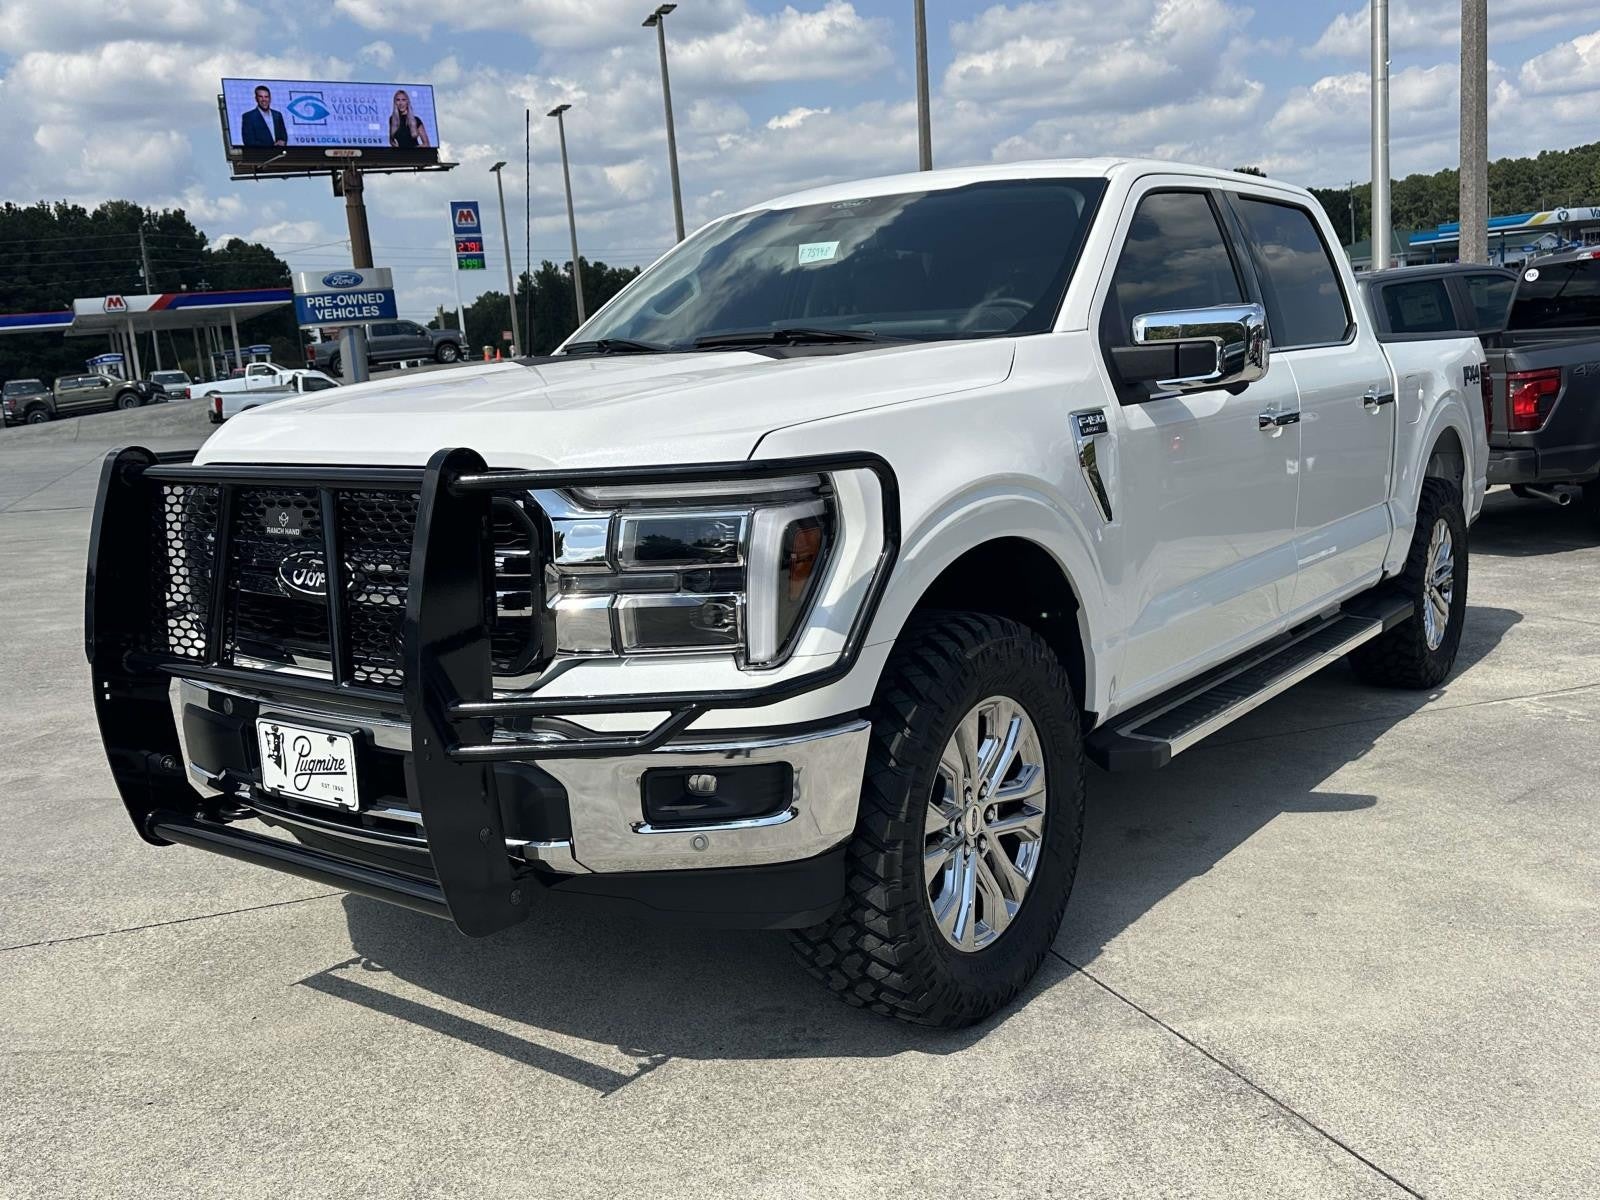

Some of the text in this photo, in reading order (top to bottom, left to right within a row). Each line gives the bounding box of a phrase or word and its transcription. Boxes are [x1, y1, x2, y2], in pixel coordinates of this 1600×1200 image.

[332, 103, 379, 115] VISION
[343, 137, 383, 145] SURGEONS
[331, 274, 355, 286] Ford
[306, 292, 385, 308] PRE-OWNED
[315, 305, 380, 319] VEHICLES
[266, 526, 300, 536] RANCH HAND
[293, 558, 326, 587] For
[293, 735, 347, 791] Pugmire
